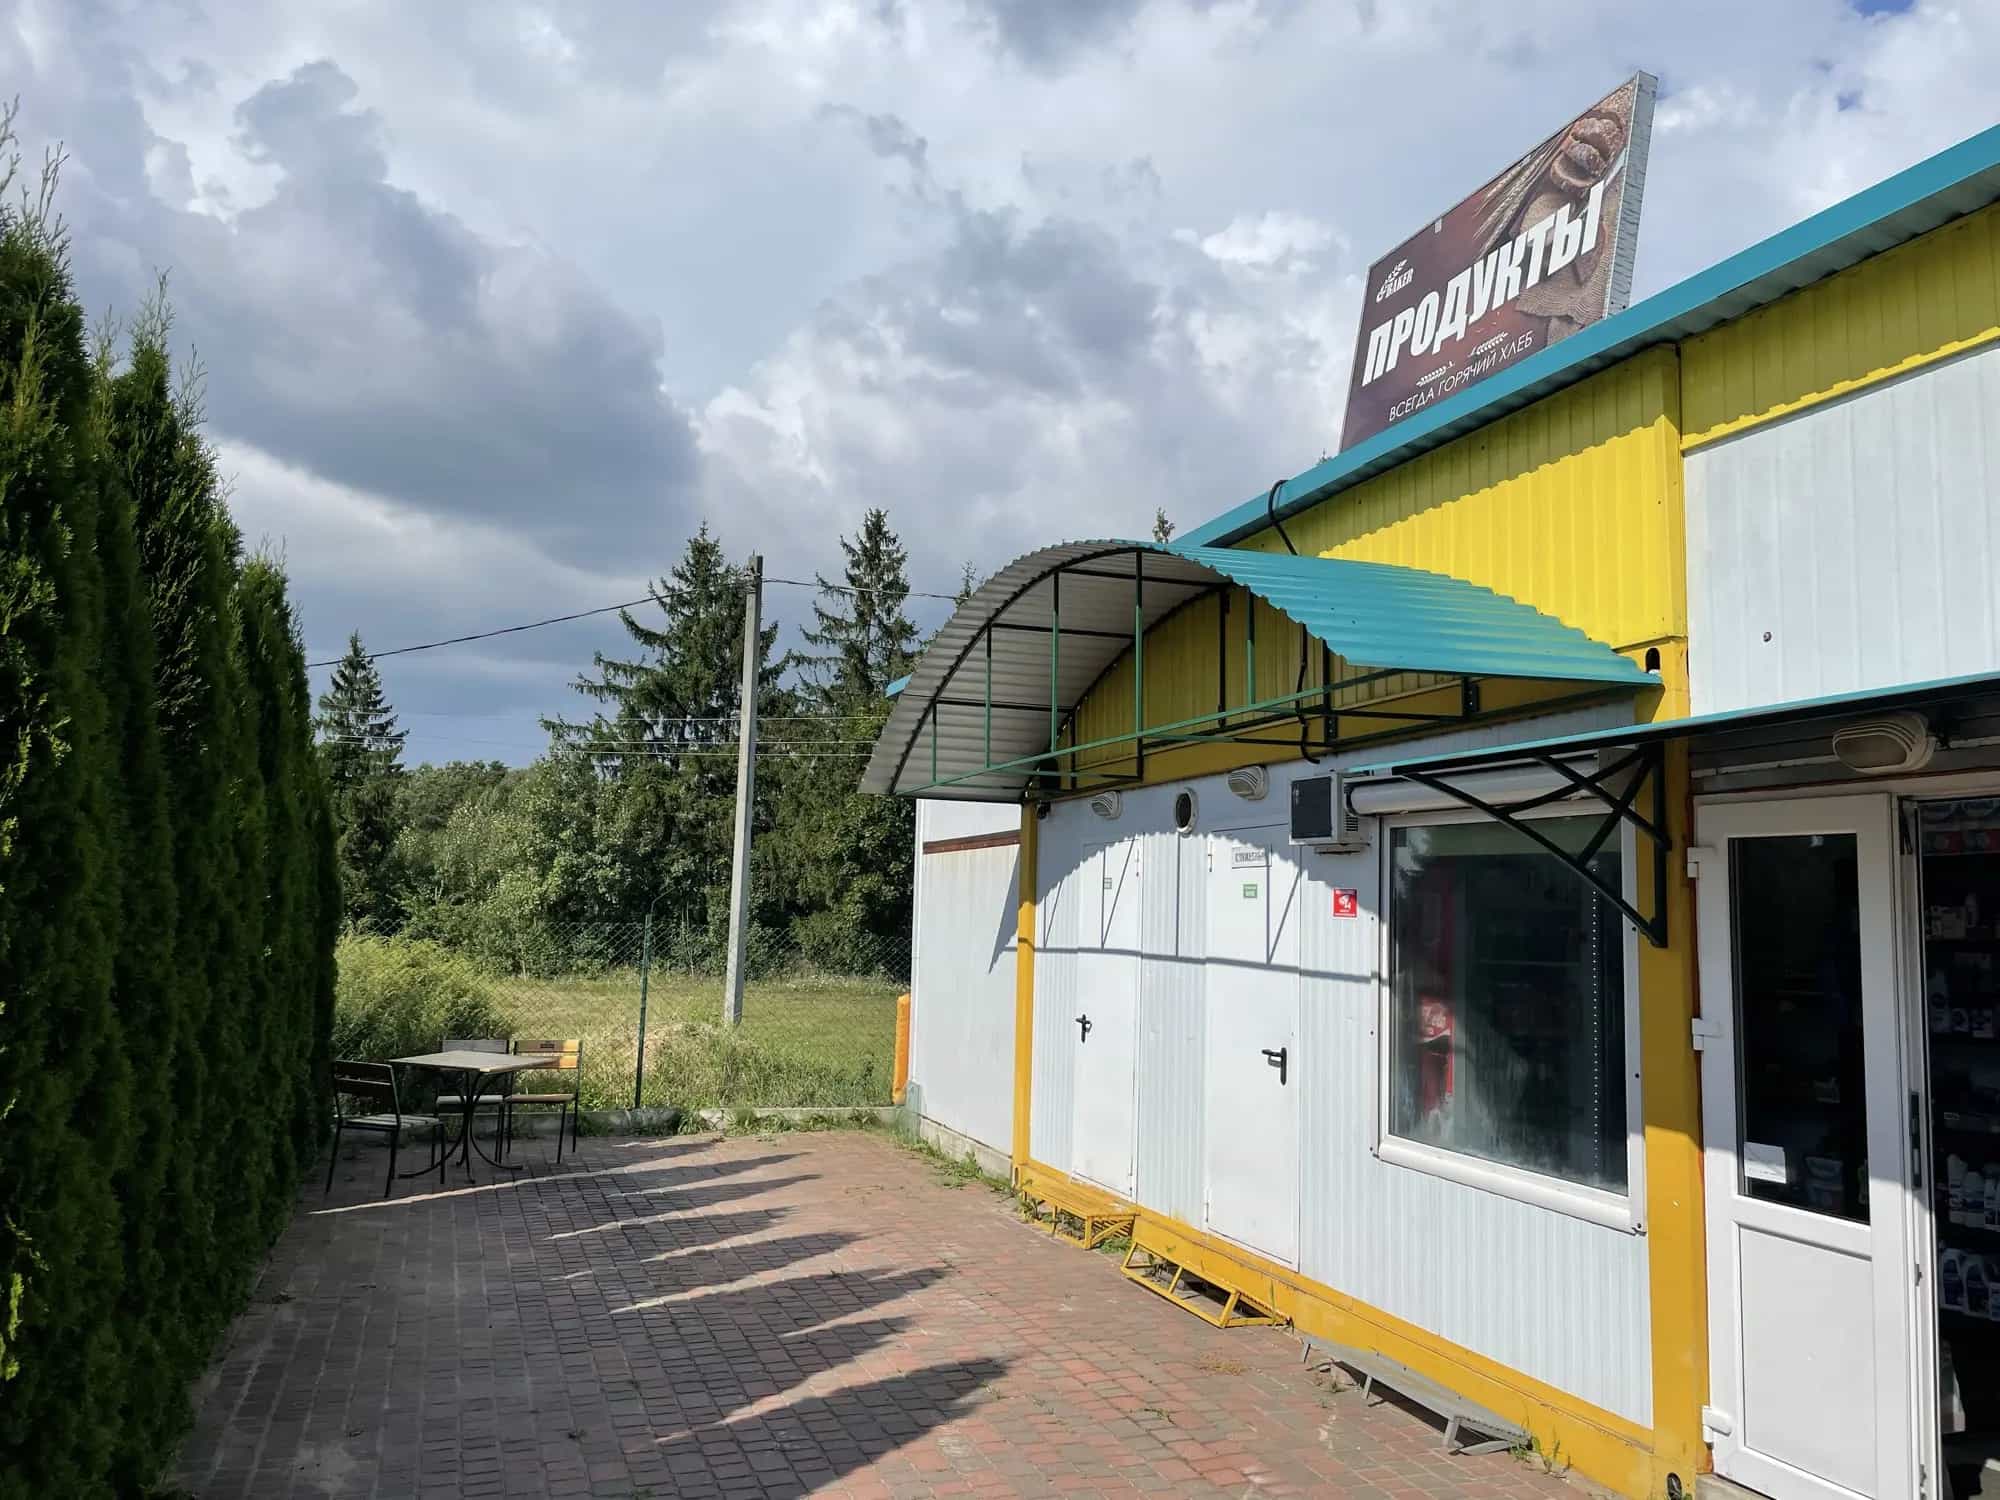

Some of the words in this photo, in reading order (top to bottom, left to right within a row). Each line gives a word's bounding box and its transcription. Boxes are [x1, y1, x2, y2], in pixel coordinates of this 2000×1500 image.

[1362, 180, 1606, 387] ПРОДУКТЫ
[1389, 388, 1434, 422] ВСЕГДА
[1438, 350, 1497, 395] ГОРЯЧИЙ
[1499, 330, 1534, 363] ХЛЕБ
